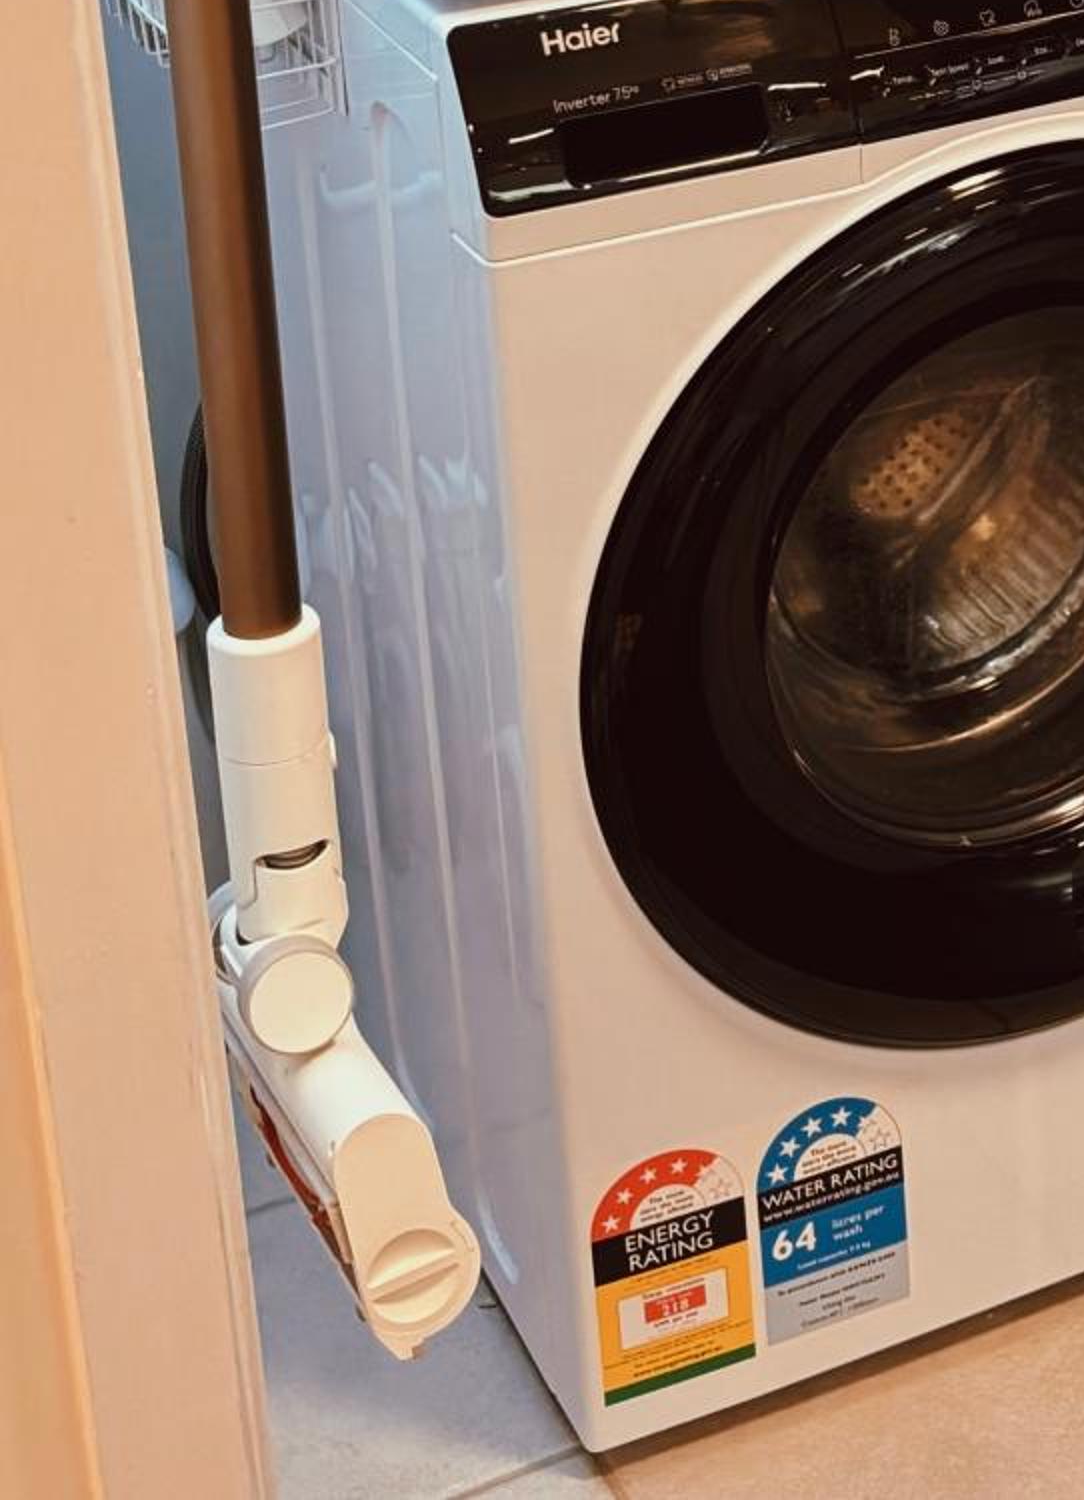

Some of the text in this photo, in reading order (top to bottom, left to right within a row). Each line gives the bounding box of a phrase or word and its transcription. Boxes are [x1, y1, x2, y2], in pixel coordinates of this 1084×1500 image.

[540, 22, 621, 56] Haier
[553, 92, 611, 114] Inverter
[761, 1153, 897, 1209] WATER RATING
[864, 1205, 885, 1220] per
[625, 1210, 713, 1253] ENERGY
[772, 1221, 817, 1261] 64
[832, 1223, 863, 1240] wash
[628, 1231, 713, 1272] RATING
